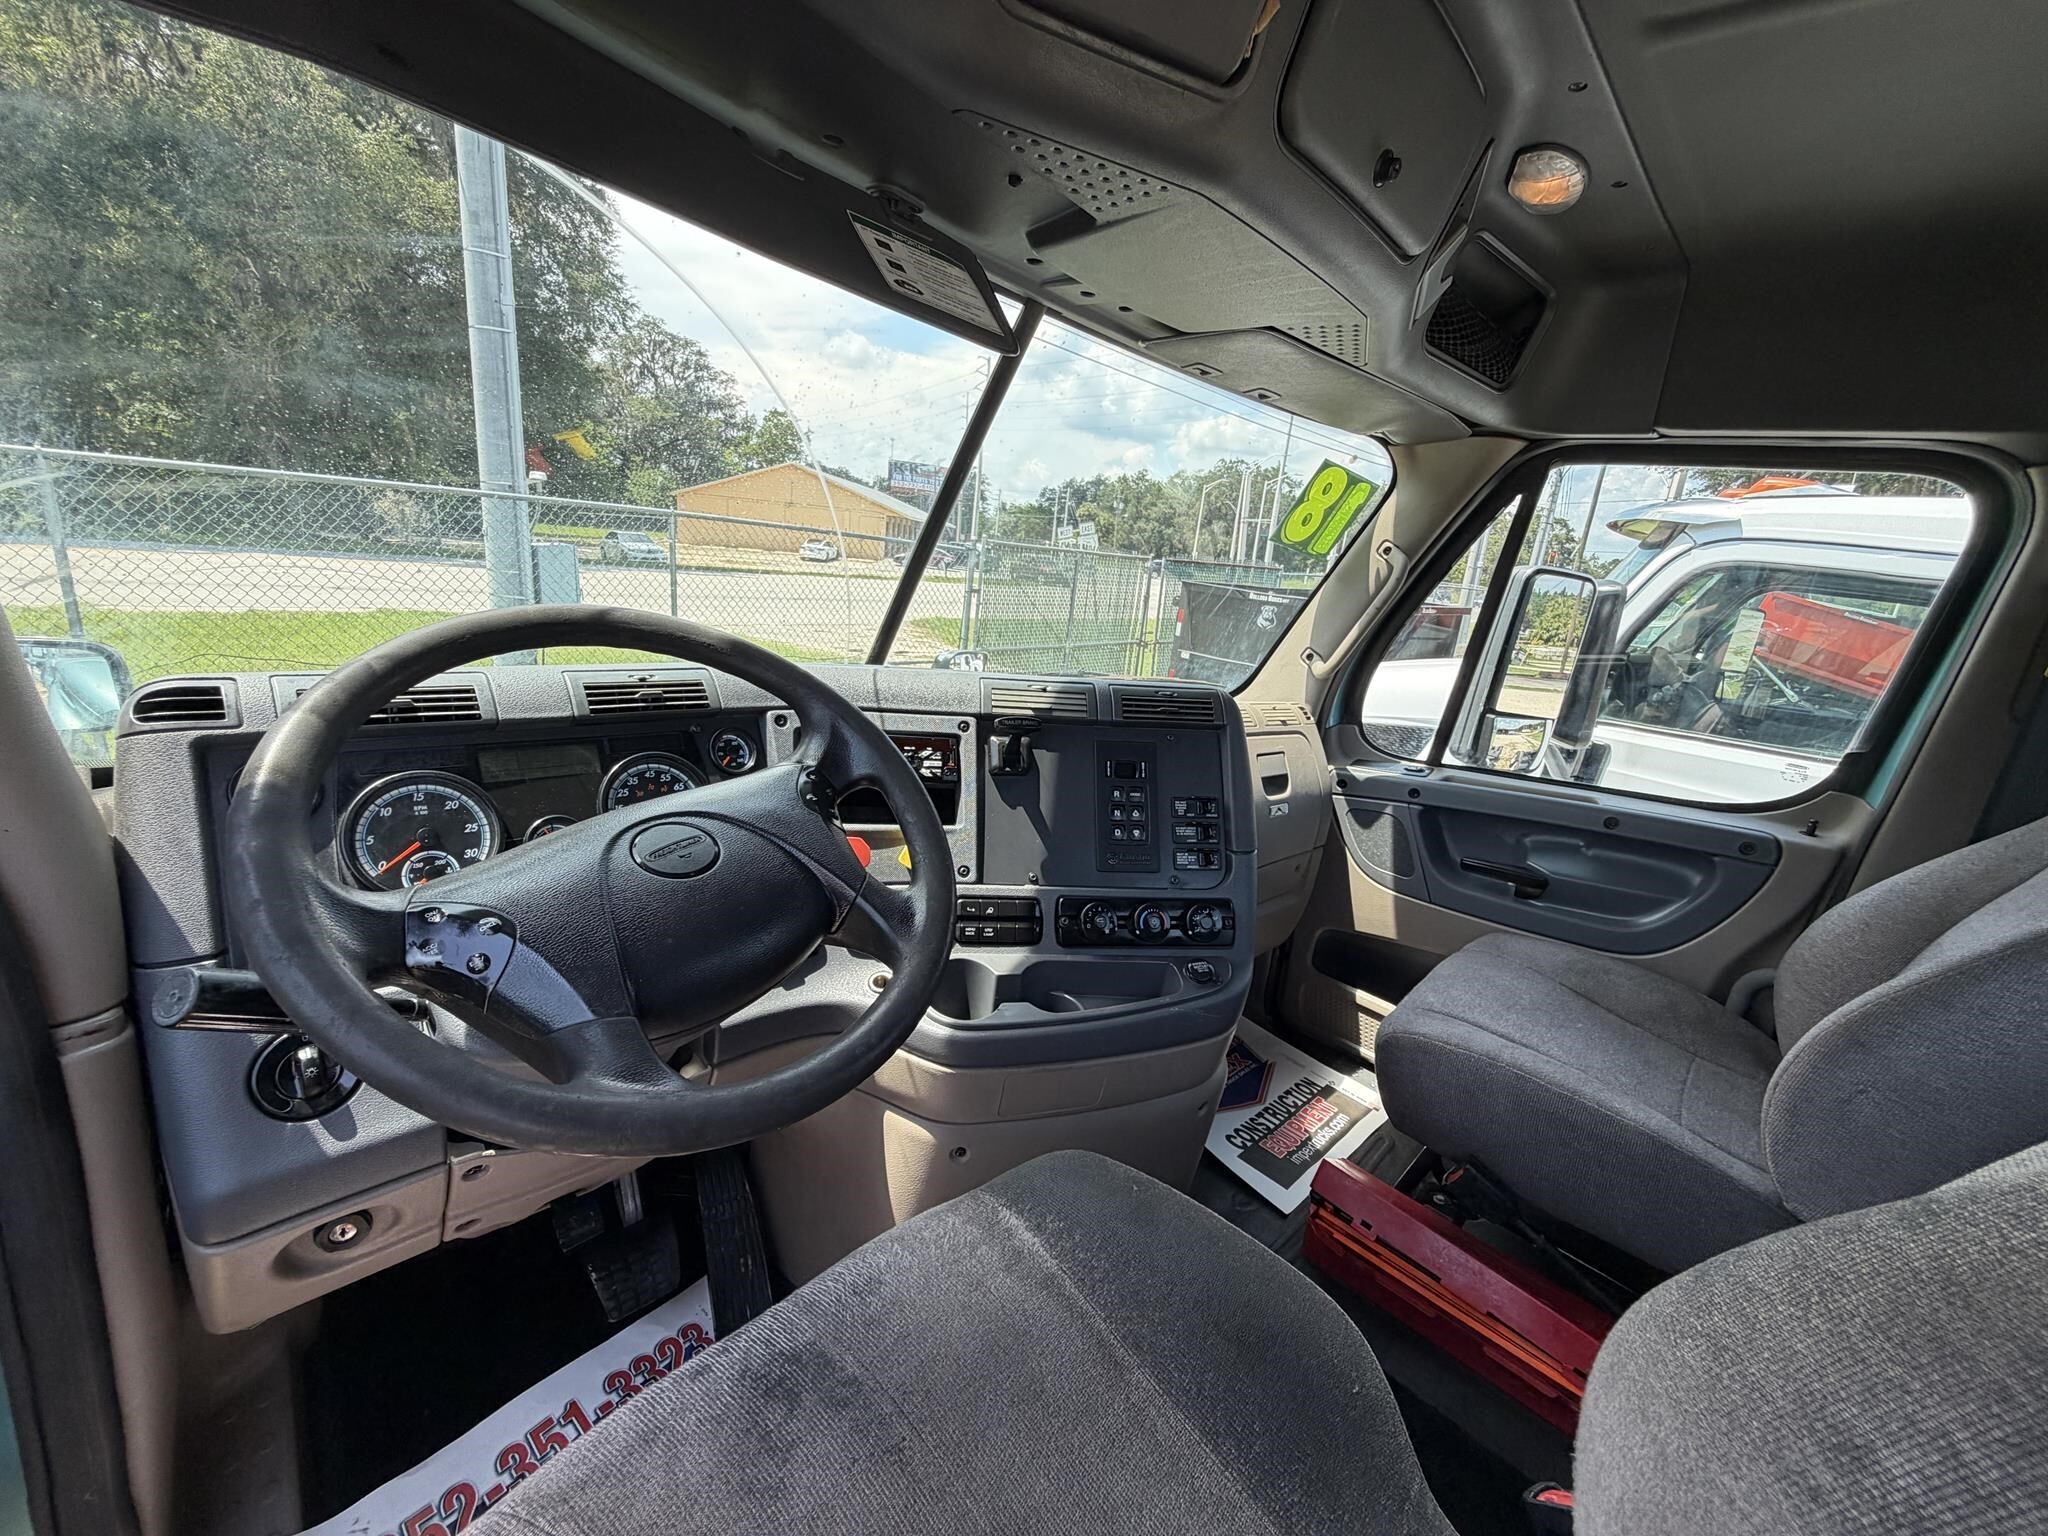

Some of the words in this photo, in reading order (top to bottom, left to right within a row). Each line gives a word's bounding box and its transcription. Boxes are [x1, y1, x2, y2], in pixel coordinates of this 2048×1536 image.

[627, 777, 639, 785] 35
[660, 774, 671, 782] 55
[673, 783, 685, 791] 65
[413, 793, 425, 801] 15
[617, 789, 629, 797] 25
[1113, 790, 1120, 798] R
[444, 801, 459, 810] 20
[380, 807, 392, 817] 10
[1114, 809, 1120, 817] N
[464, 823, 479, 833] 25
[365, 836, 374, 845] 5
[464, 848, 478, 858] 30
[378, 861, 386, 871] 0
[1224, 1076, 1324, 1150] CONSTRUCTION
[1258, 1096, 1338, 1159] EQUIPMENT
[1287, 1113, 1351, 1165] impextrucks.com
[379, 1322, 716, 1536] 52-351-3323
